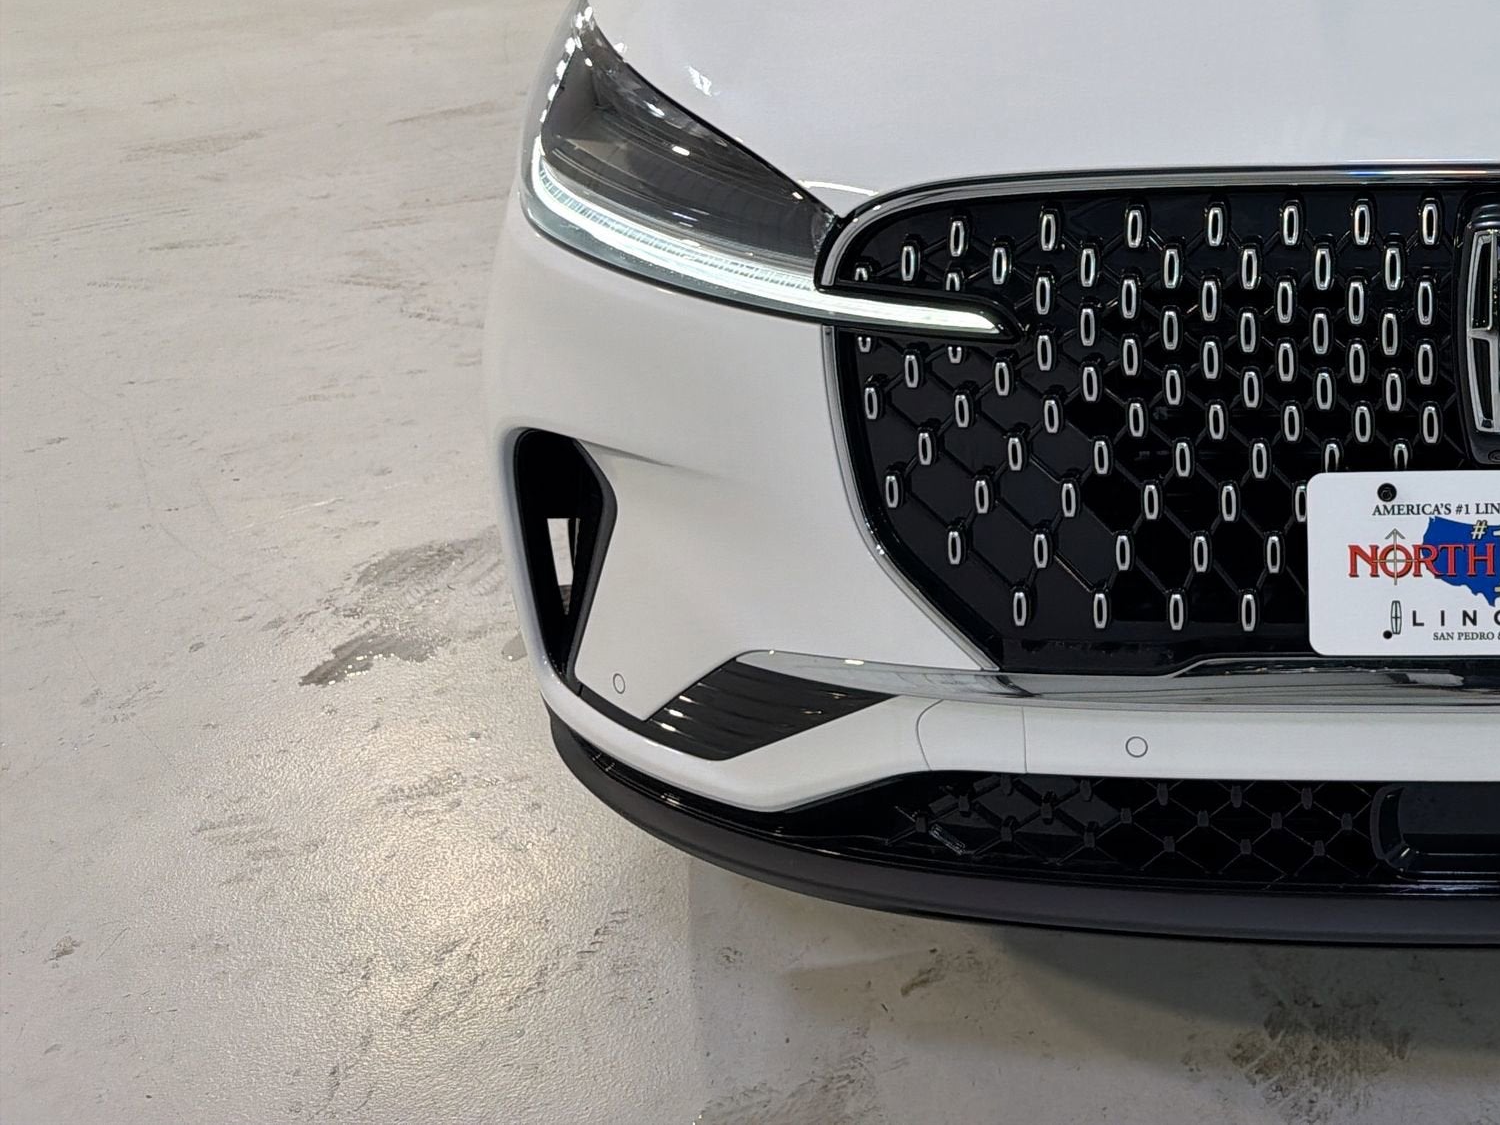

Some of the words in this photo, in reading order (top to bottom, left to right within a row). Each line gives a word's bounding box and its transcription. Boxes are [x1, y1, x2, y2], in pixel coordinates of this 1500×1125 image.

[1371, 502, 1452, 516] AMERICA'S
[1455, 503, 1471, 516] #1
[1347, 542, 1497, 579] NORTH
[1432, 631, 1455, 641] SAN
[1457, 631, 1495, 641] PEDRO
